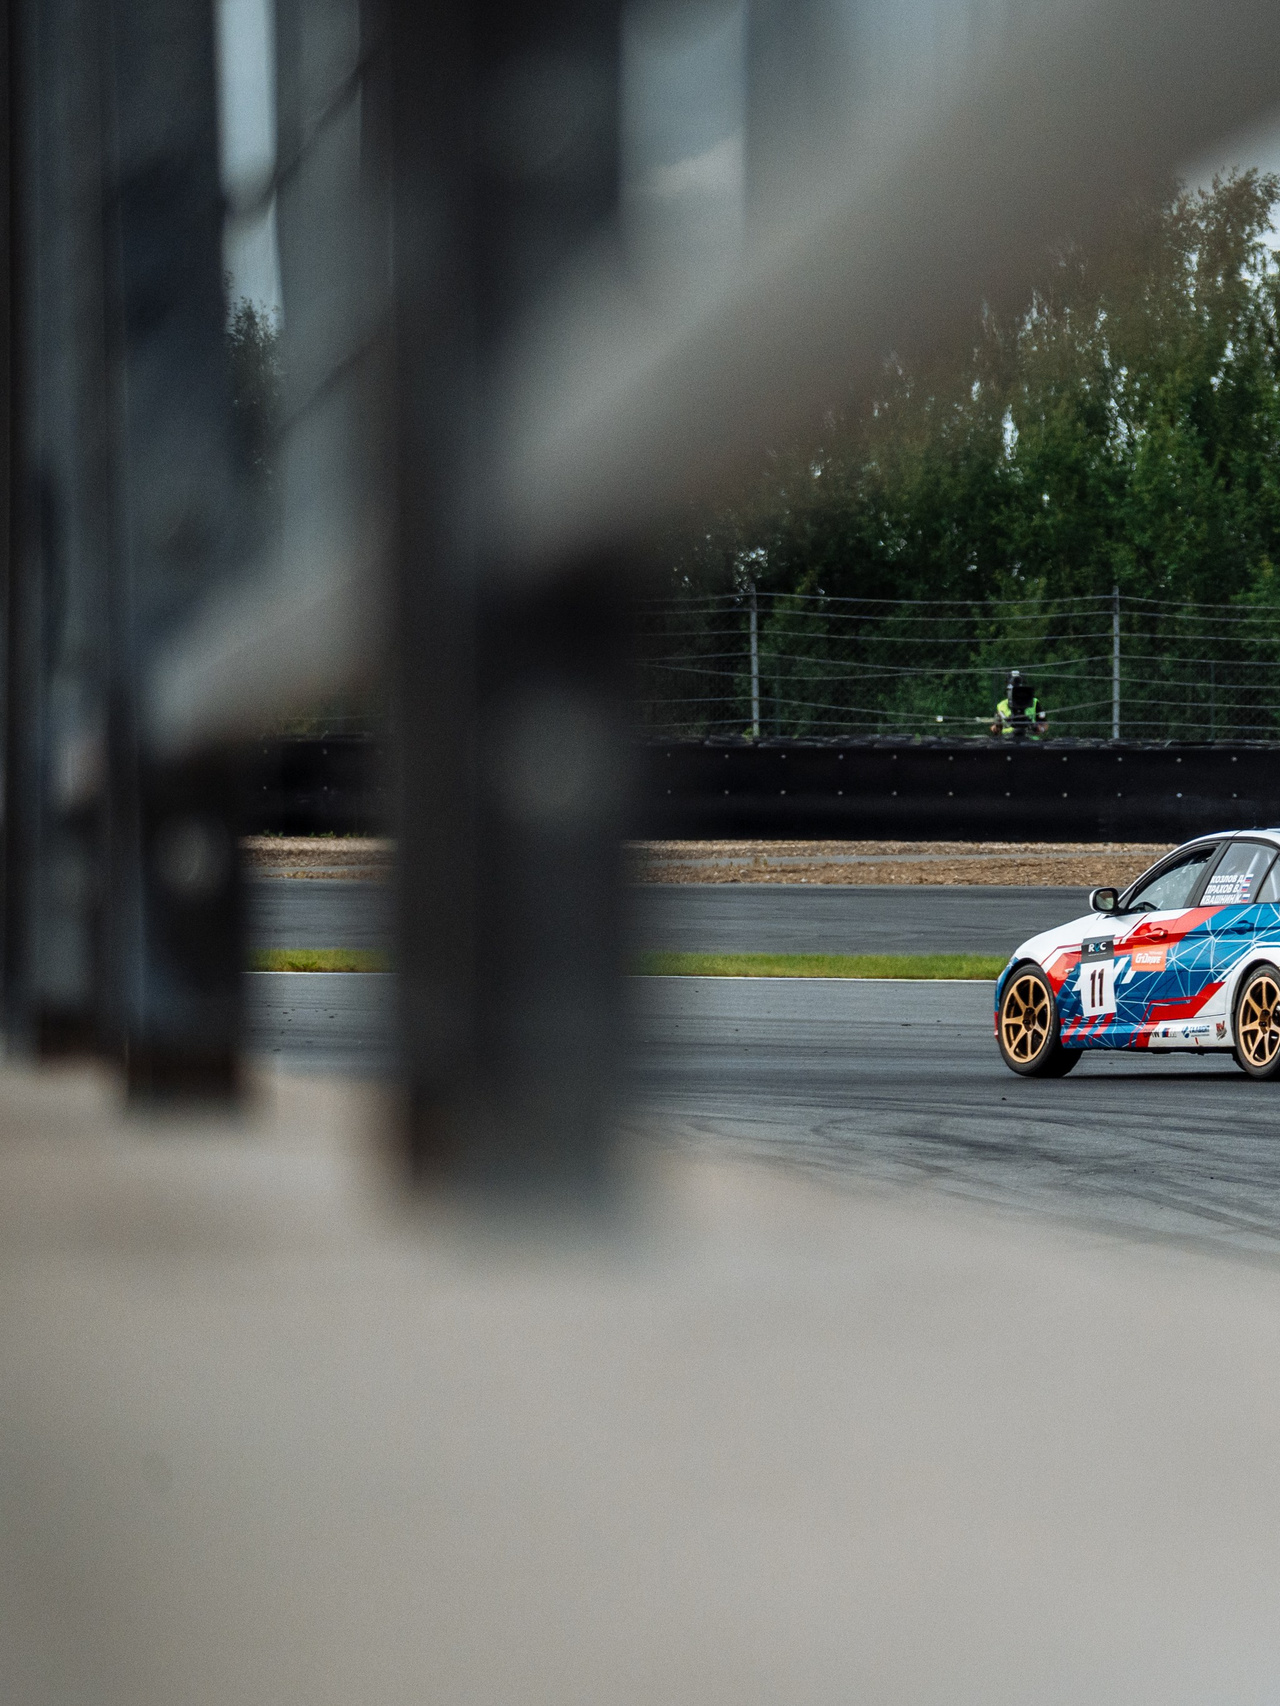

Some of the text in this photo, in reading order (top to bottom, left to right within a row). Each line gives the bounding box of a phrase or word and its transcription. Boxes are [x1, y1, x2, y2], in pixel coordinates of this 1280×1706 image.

[1210, 874, 1237, 884] КОЗЛОВ
[1205, 884, 1233, 894] ПРАХОВ
[1090, 968, 1104, 1008] 11
